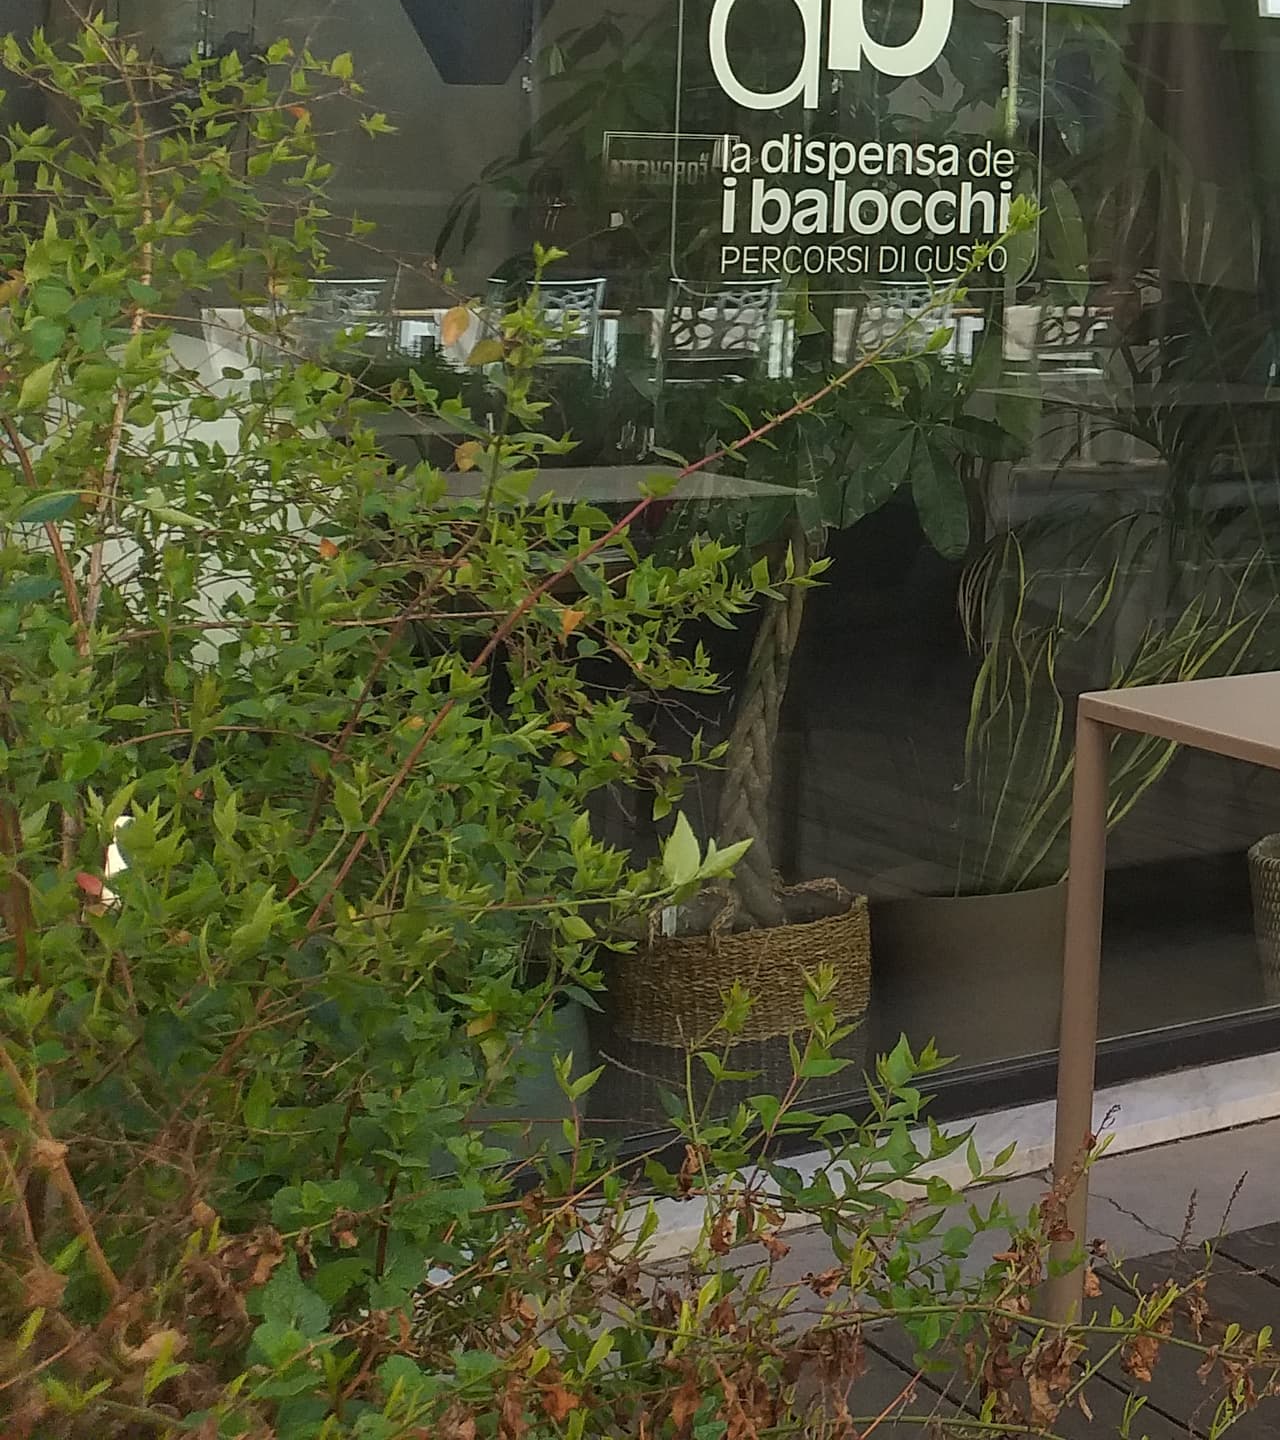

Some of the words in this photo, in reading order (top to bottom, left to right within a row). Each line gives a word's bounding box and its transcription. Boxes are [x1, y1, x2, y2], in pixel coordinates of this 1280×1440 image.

[722, 134, 750, 173] la
[760, 133, 959, 181] dispensa
[968, 140, 1016, 178] de
[721, 176, 738, 234] i
[750, 178, 1014, 235] balocchi
[720, 246, 869, 274] PERCORSI
[878, 246, 906, 273] DI
